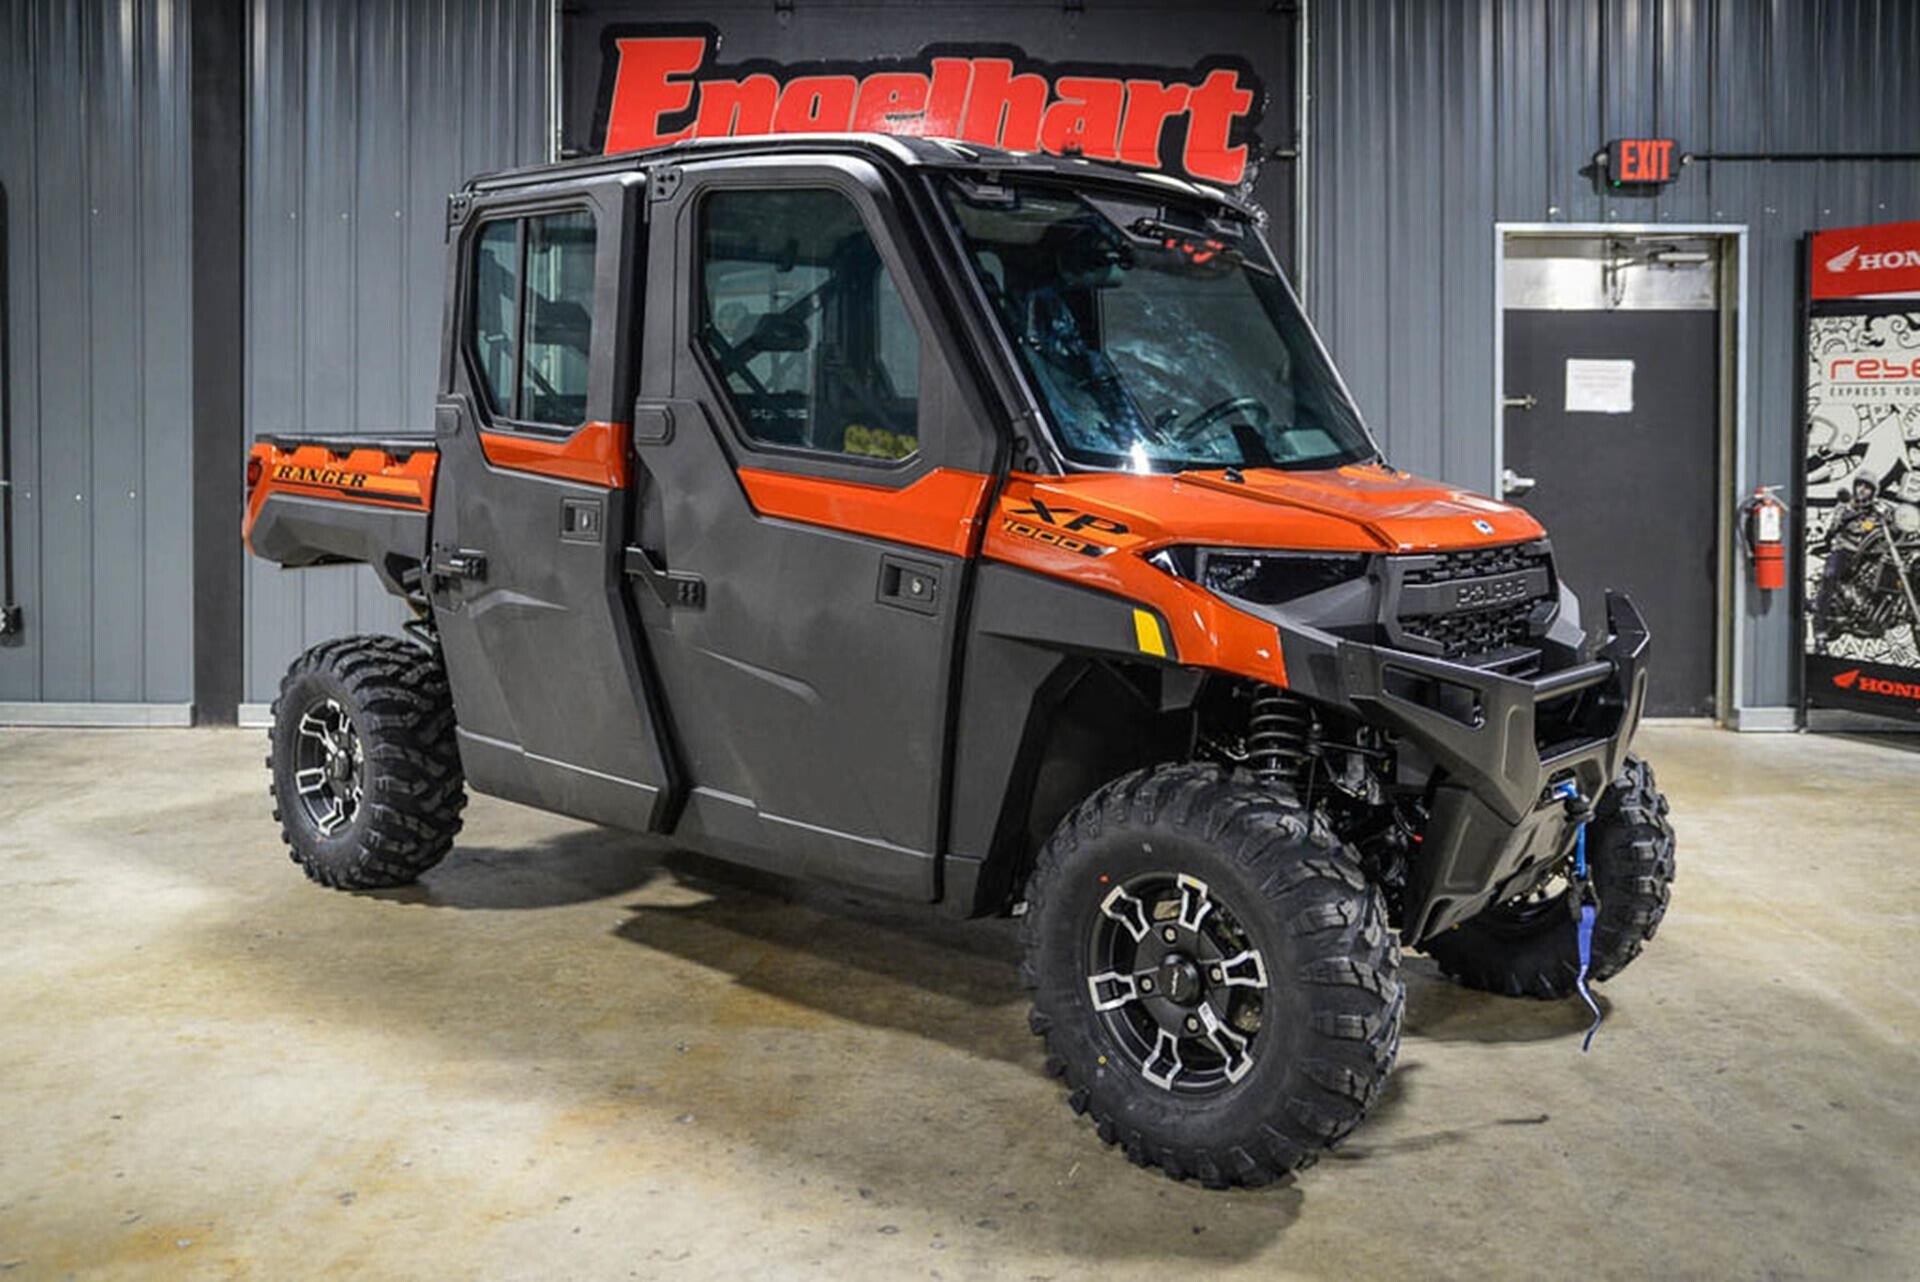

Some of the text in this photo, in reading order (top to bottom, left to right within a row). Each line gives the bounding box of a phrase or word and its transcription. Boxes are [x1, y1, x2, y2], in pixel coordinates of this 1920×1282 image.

[604, 37, 1253, 184] Engelhart
[1621, 139, 1674, 181] EXIT
[1859, 251, 1920, 271] HON
[277, 464, 367, 488] RANGER
[1009, 498, 1129, 534] XP
[1004, 518, 1085, 552] 1000
